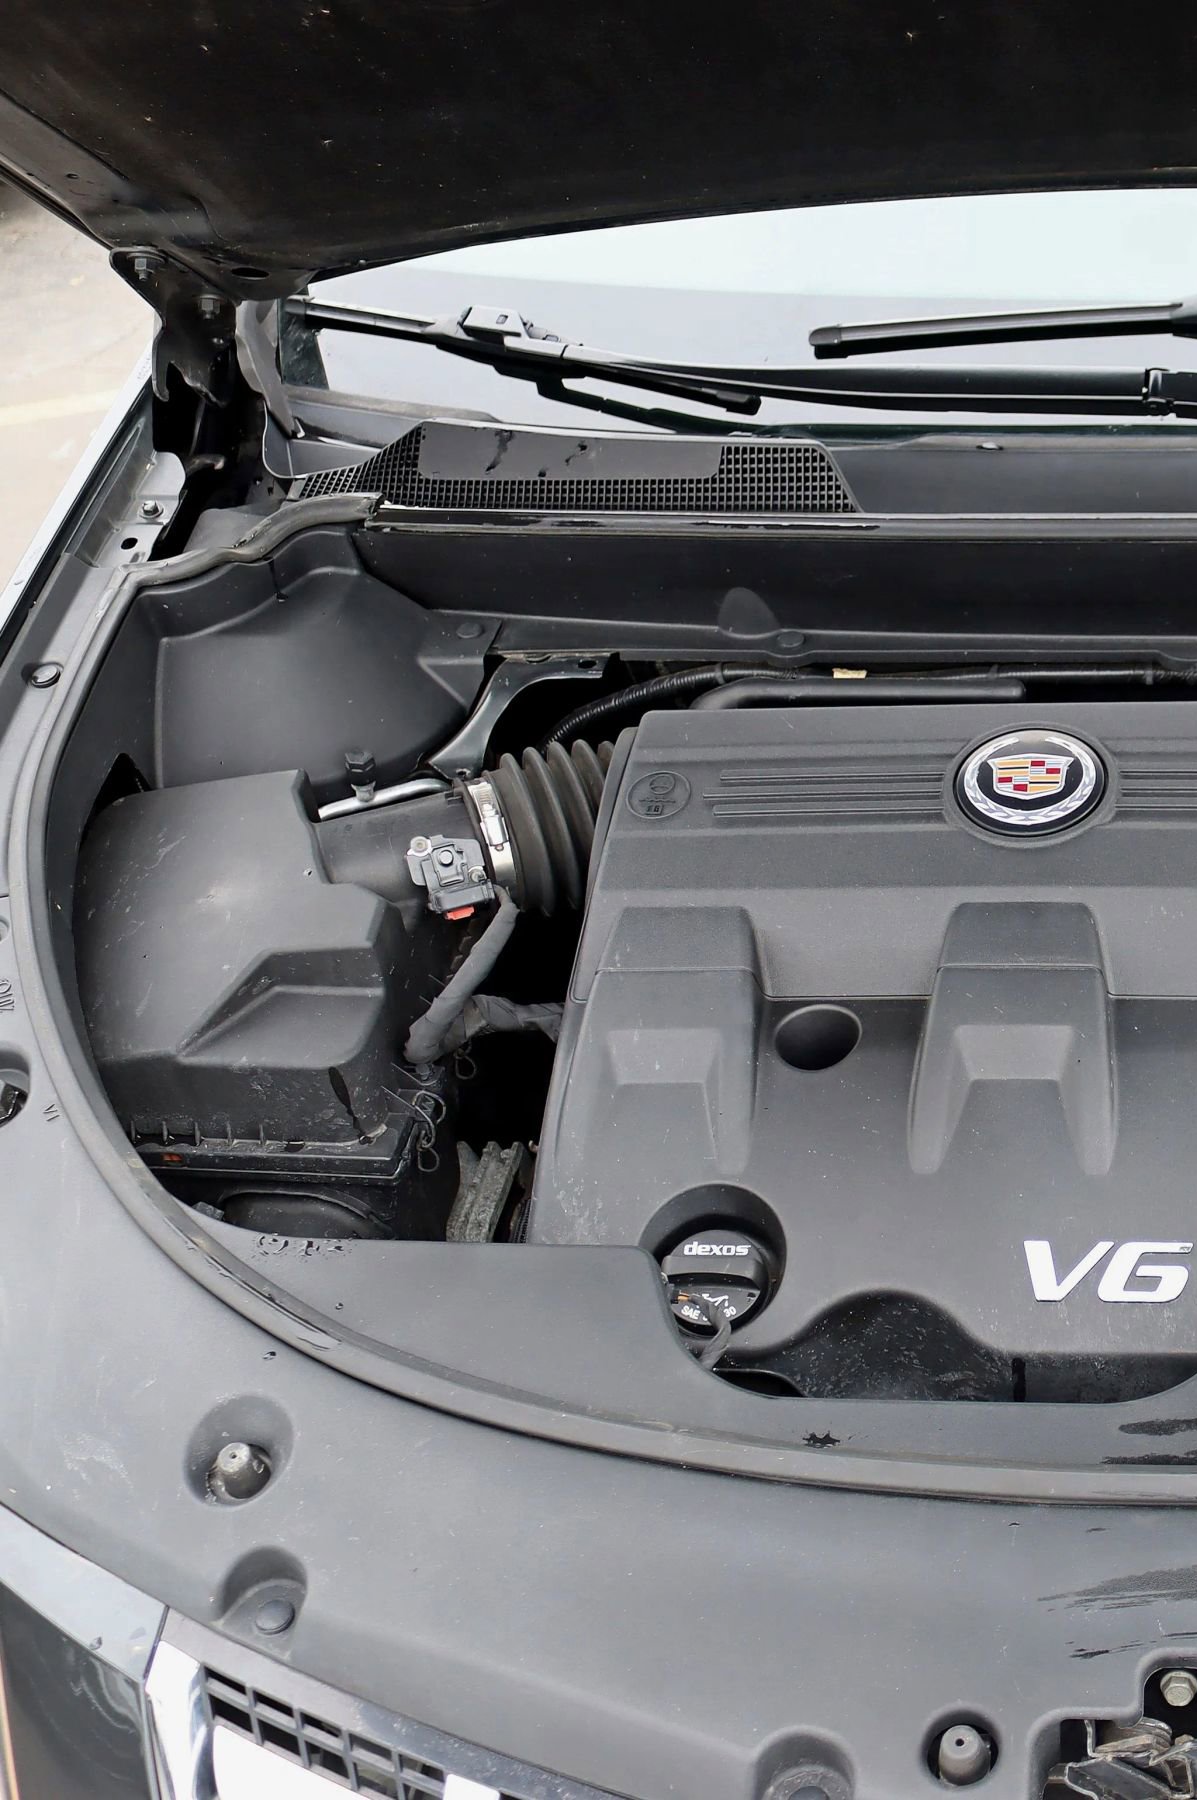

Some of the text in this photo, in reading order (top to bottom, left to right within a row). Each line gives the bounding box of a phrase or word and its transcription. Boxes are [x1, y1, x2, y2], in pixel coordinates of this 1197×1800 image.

[683, 1241, 750, 1256] dexos
[1023, 1240, 1194, 1302] V6
[681, 1305, 701, 1320] SAE
